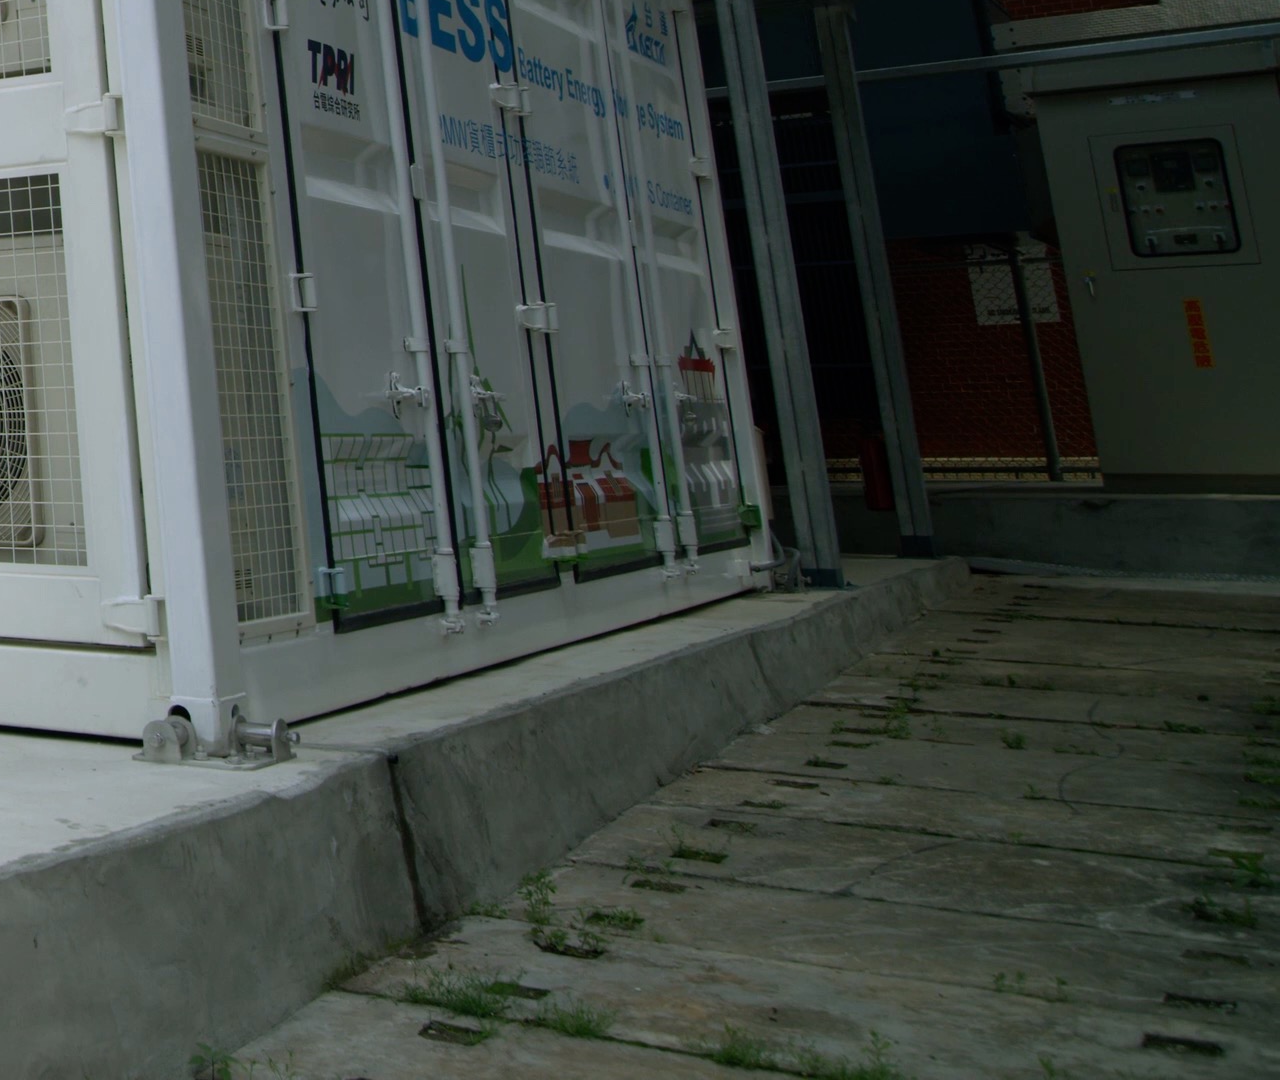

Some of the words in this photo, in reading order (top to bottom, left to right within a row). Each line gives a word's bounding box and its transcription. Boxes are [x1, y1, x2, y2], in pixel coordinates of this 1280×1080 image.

[307, 38, 355, 97] TPRI
[517, 47, 564, 101] Battery
[565, 67, 606, 119] Energy
[647, 102, 684, 141] System
[656, 183, 693, 217] Container
